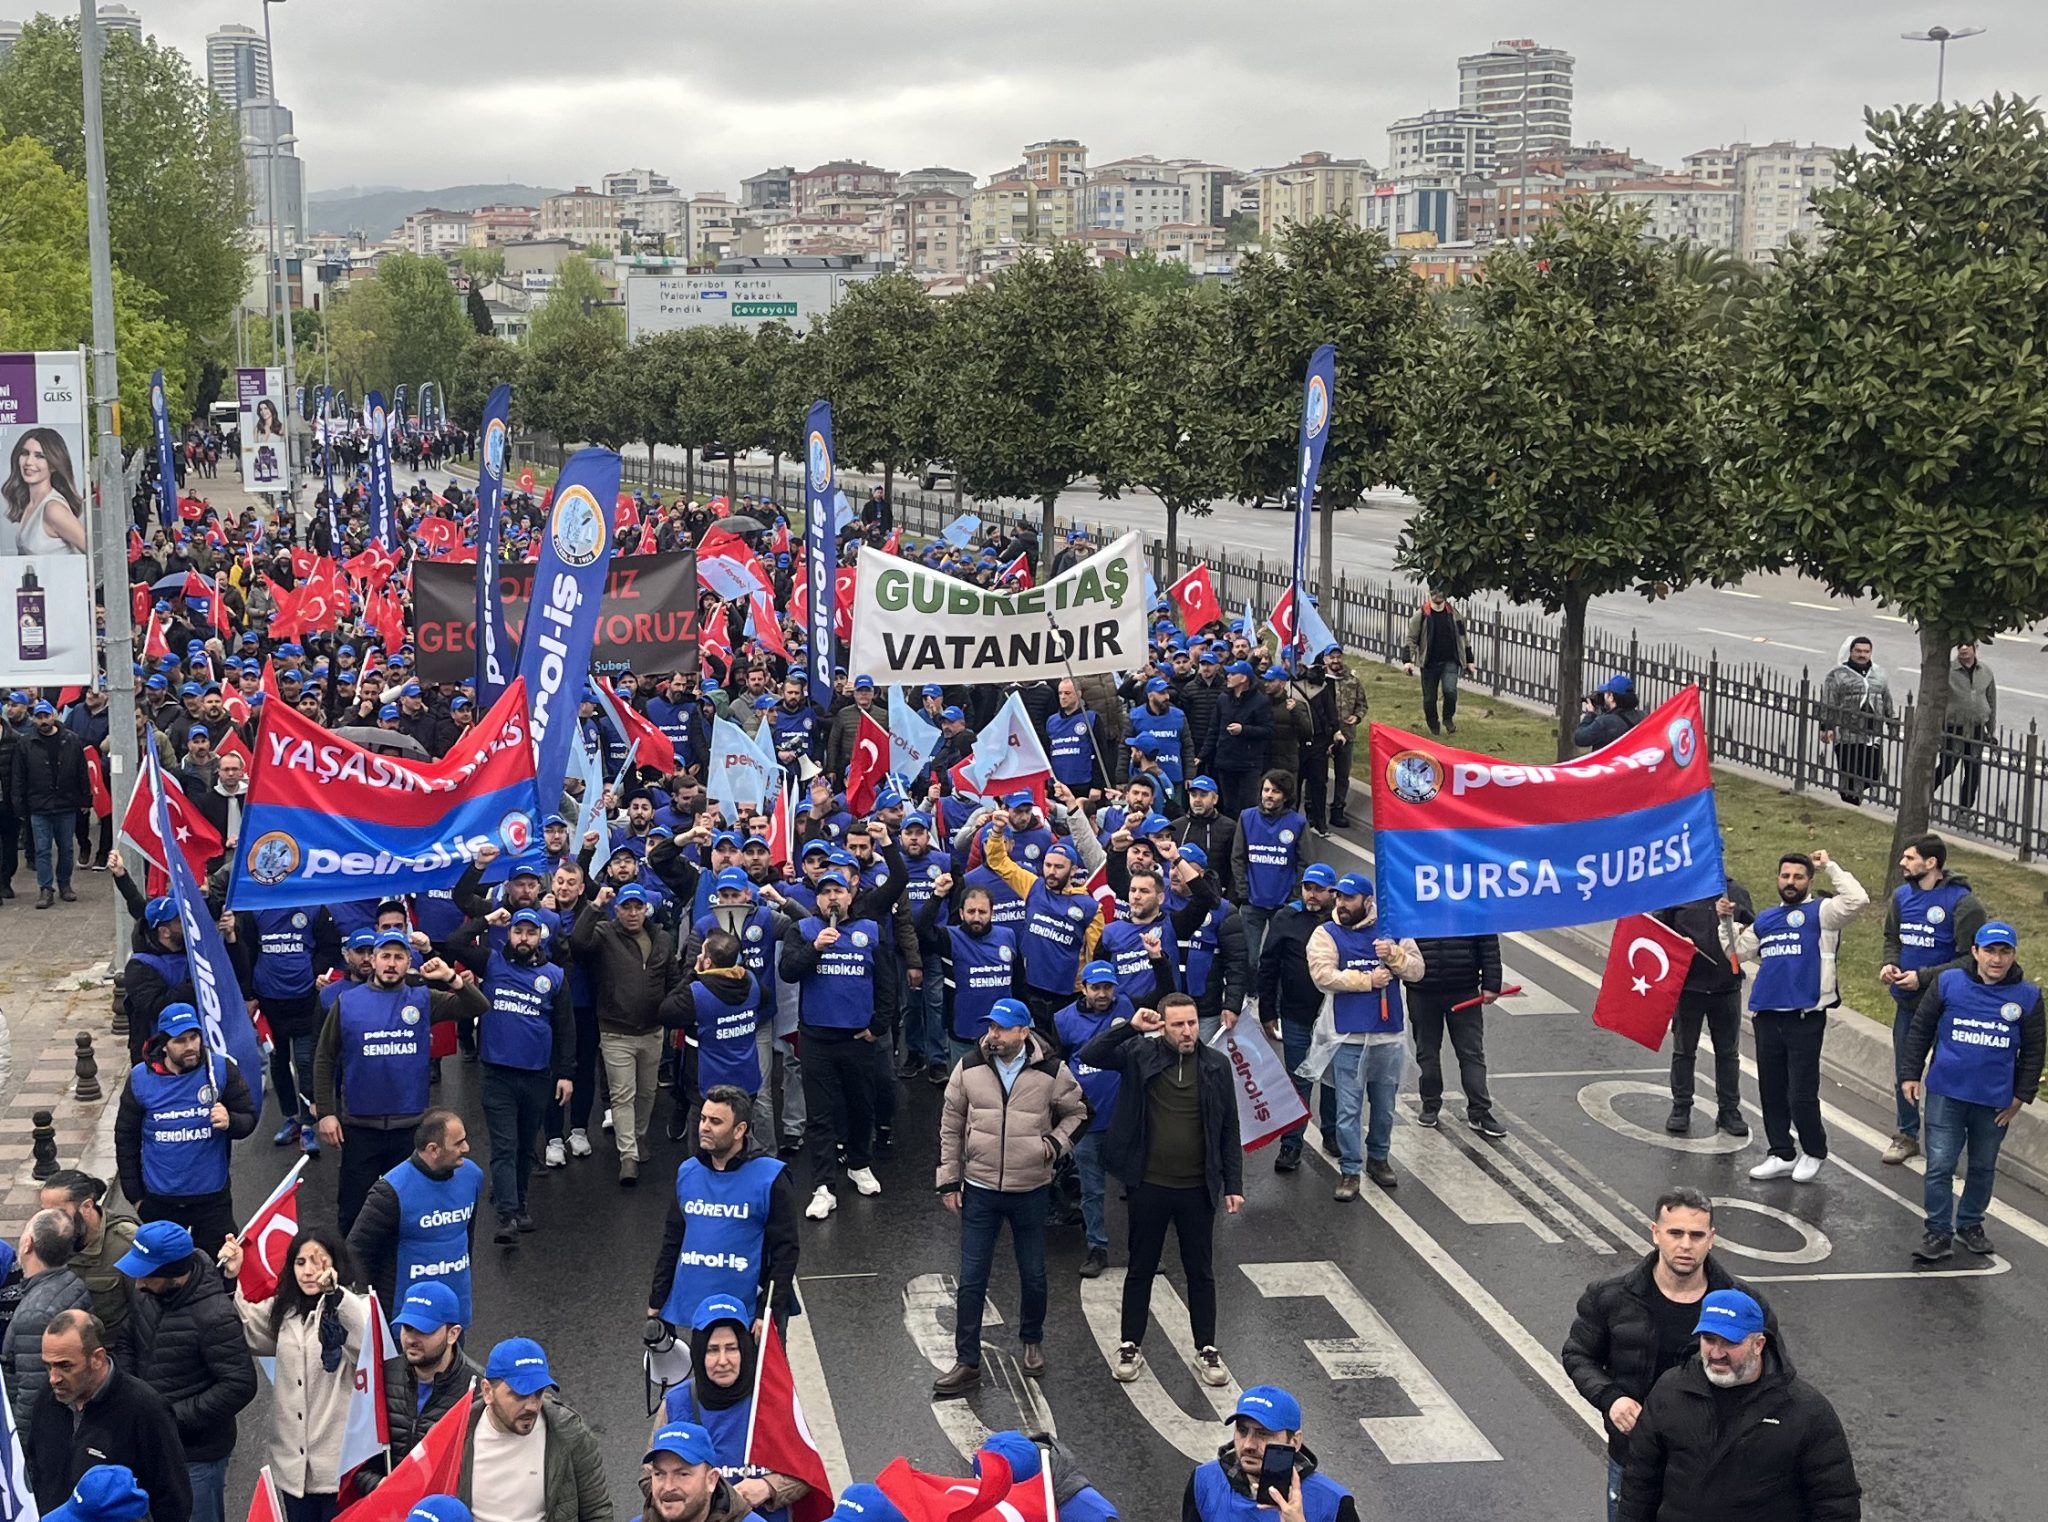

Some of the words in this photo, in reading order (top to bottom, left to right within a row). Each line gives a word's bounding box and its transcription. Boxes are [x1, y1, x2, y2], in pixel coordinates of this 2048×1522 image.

[736, 292, 783, 300] Yakacık
[660, 305, 702, 313] Pendik
[734, 305, 796, 315] Çevreyolu
[44, 392, 72, 402] GLISS
[812, 498, 831, 688] petrol-iş
[882, 619, 1123, 671] VATANDIR
[594, 659, 631, 672] Şubesi
[1415, 858, 1560, 901] BURSA
[1576, 822, 1693, 900] ŞUBESİ
[1029, 923, 1073, 946] SENDİKASI
[816, 964, 864, 976] SENDİKASI
[364, 1029, 415, 1040] petrol-iş
[1952, 1029, 2010, 1048] SENDİKASI
[363, 1041, 417, 1056] SENDİKASI
[153, 1107, 210, 1121] petrol-iş
[155, 1127, 211, 1142] SENDİKASI
[685, 1199, 748, 1219] GÖREVLİ
